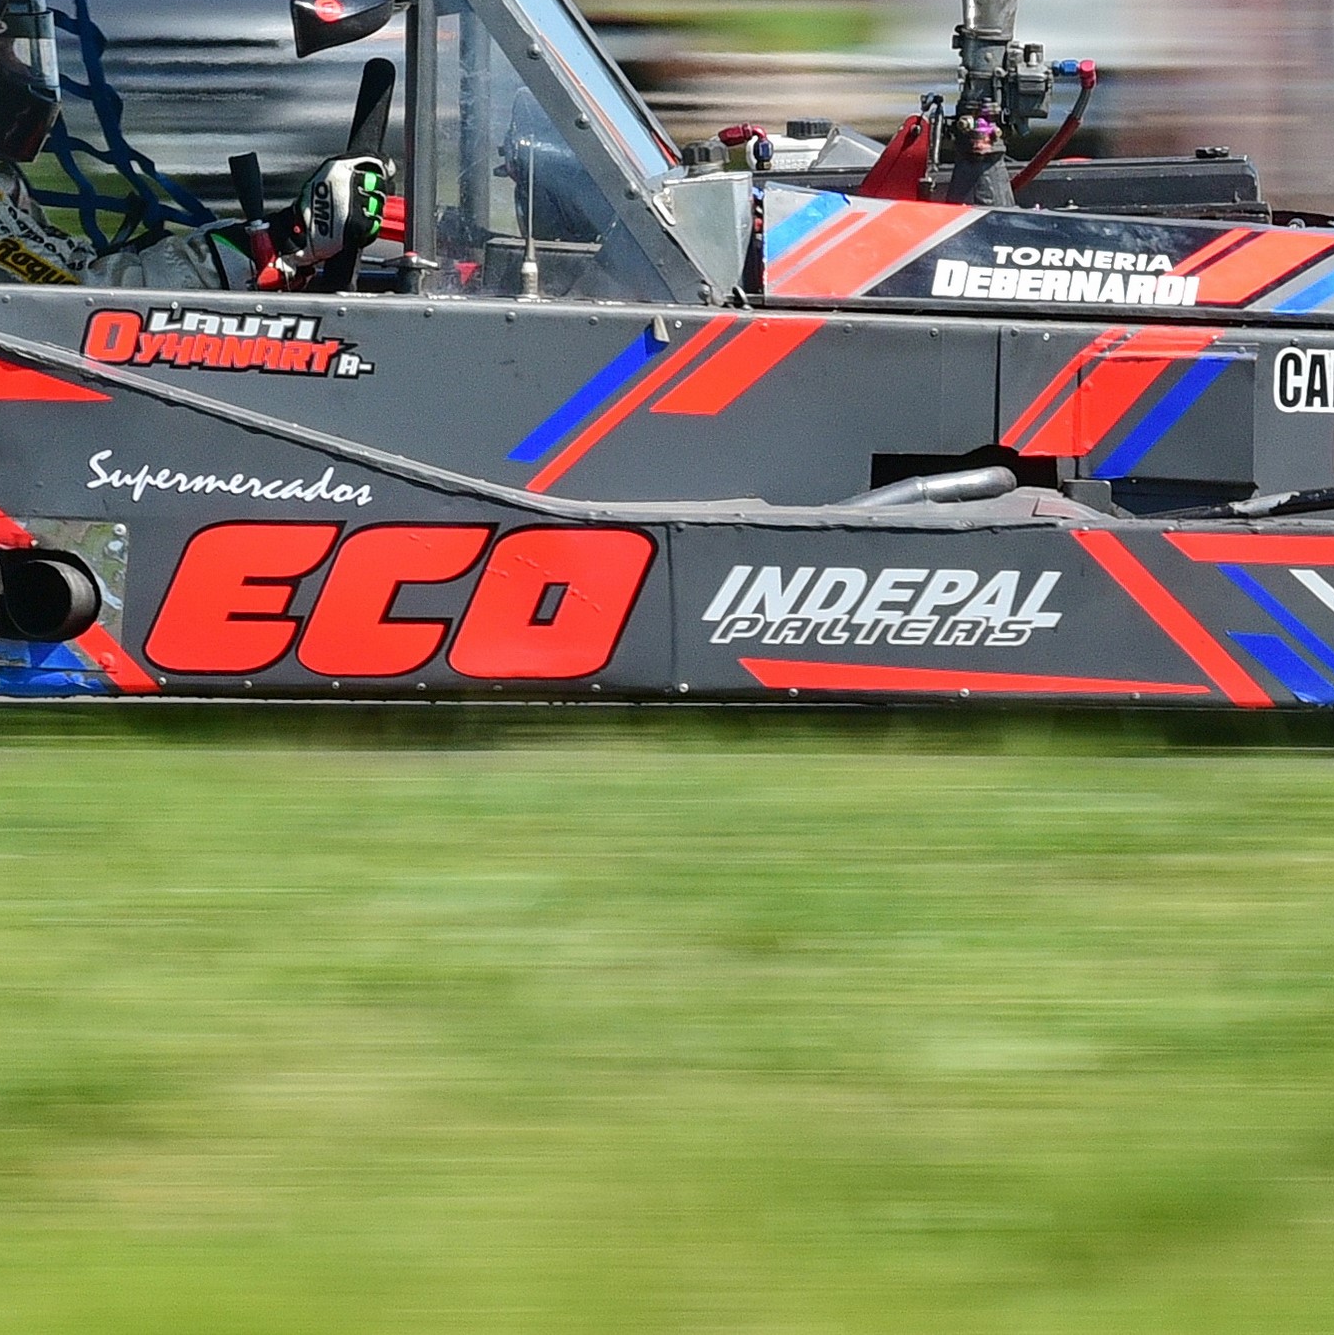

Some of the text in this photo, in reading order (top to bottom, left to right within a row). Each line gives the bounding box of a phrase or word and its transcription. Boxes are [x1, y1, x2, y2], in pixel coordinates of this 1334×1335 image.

[314, 181, 330, 237] OMP
[930, 258, 1201, 307] DEBERNARDI
[992, 245, 1175, 272] TORNERIA
[149, 313, 317, 340] LAUTI
[86, 449, 373, 506] Supermercados
[142, 520, 658, 679] ECO
[701, 564, 1063, 628] INDEPAL
[709, 613, 1037, 646] PALIERS
